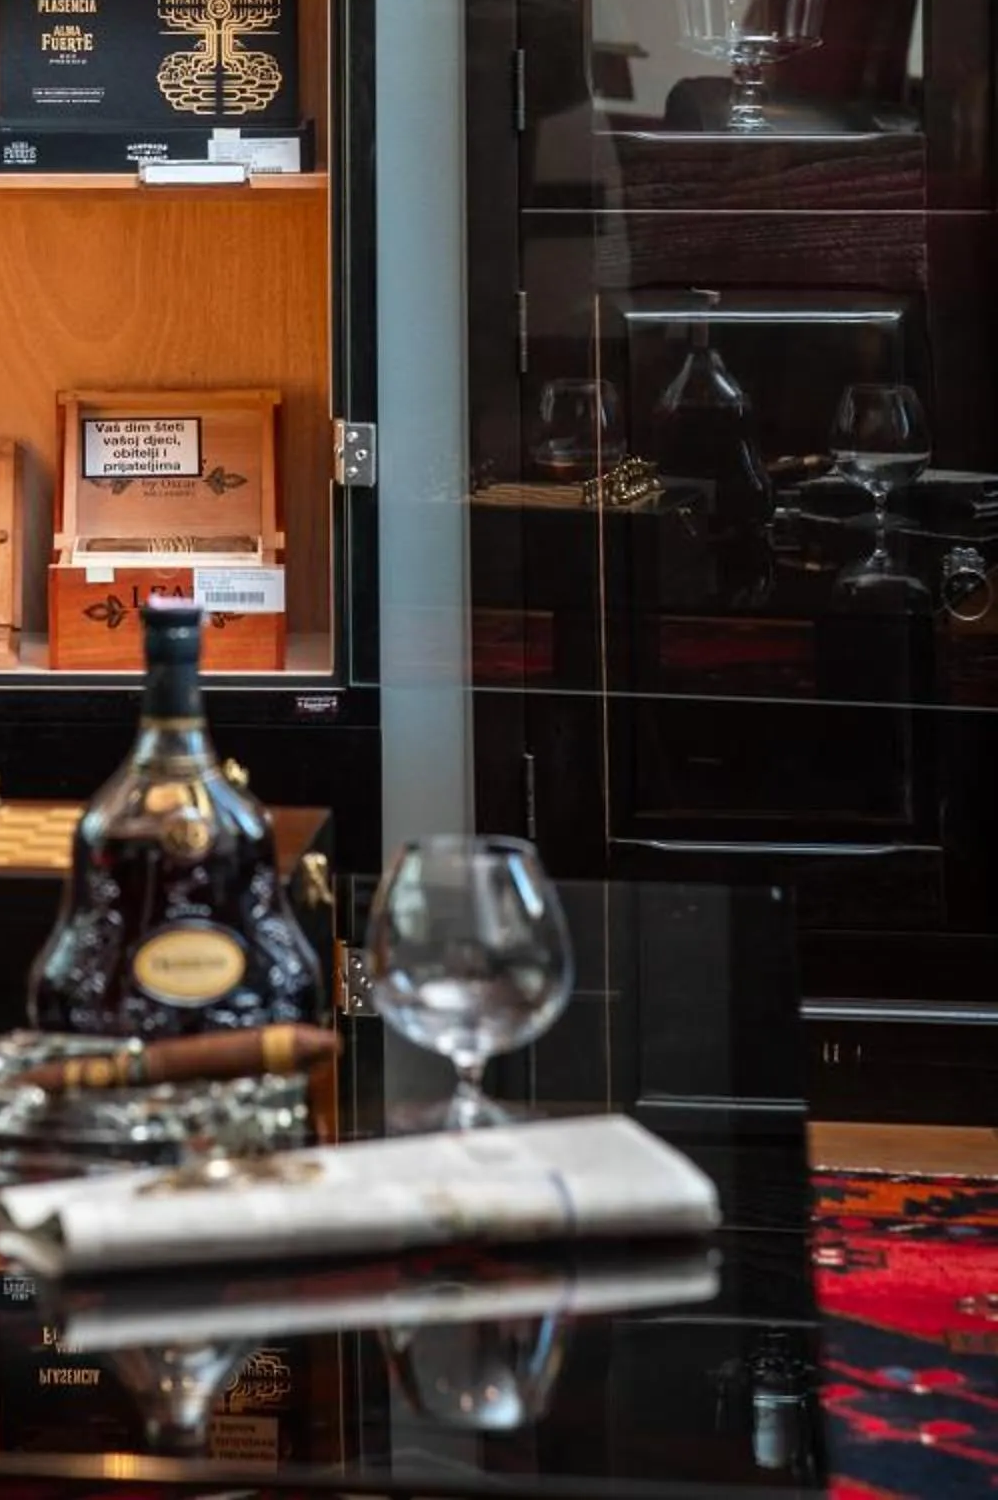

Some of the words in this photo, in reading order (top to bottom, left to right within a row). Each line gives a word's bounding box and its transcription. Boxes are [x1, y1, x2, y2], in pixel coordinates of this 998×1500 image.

[53, 24, 82, 37] ALMA
[41, 33, 94, 52] FUERTE
[95, 422, 121, 433] Vaš
[125, 422, 151, 433] dim
[154, 421, 185, 433] šteti
[103, 435, 139, 446] vašoj
[143, 435, 181, 446] djeci,
[103, 459, 181, 472] prijateljima
